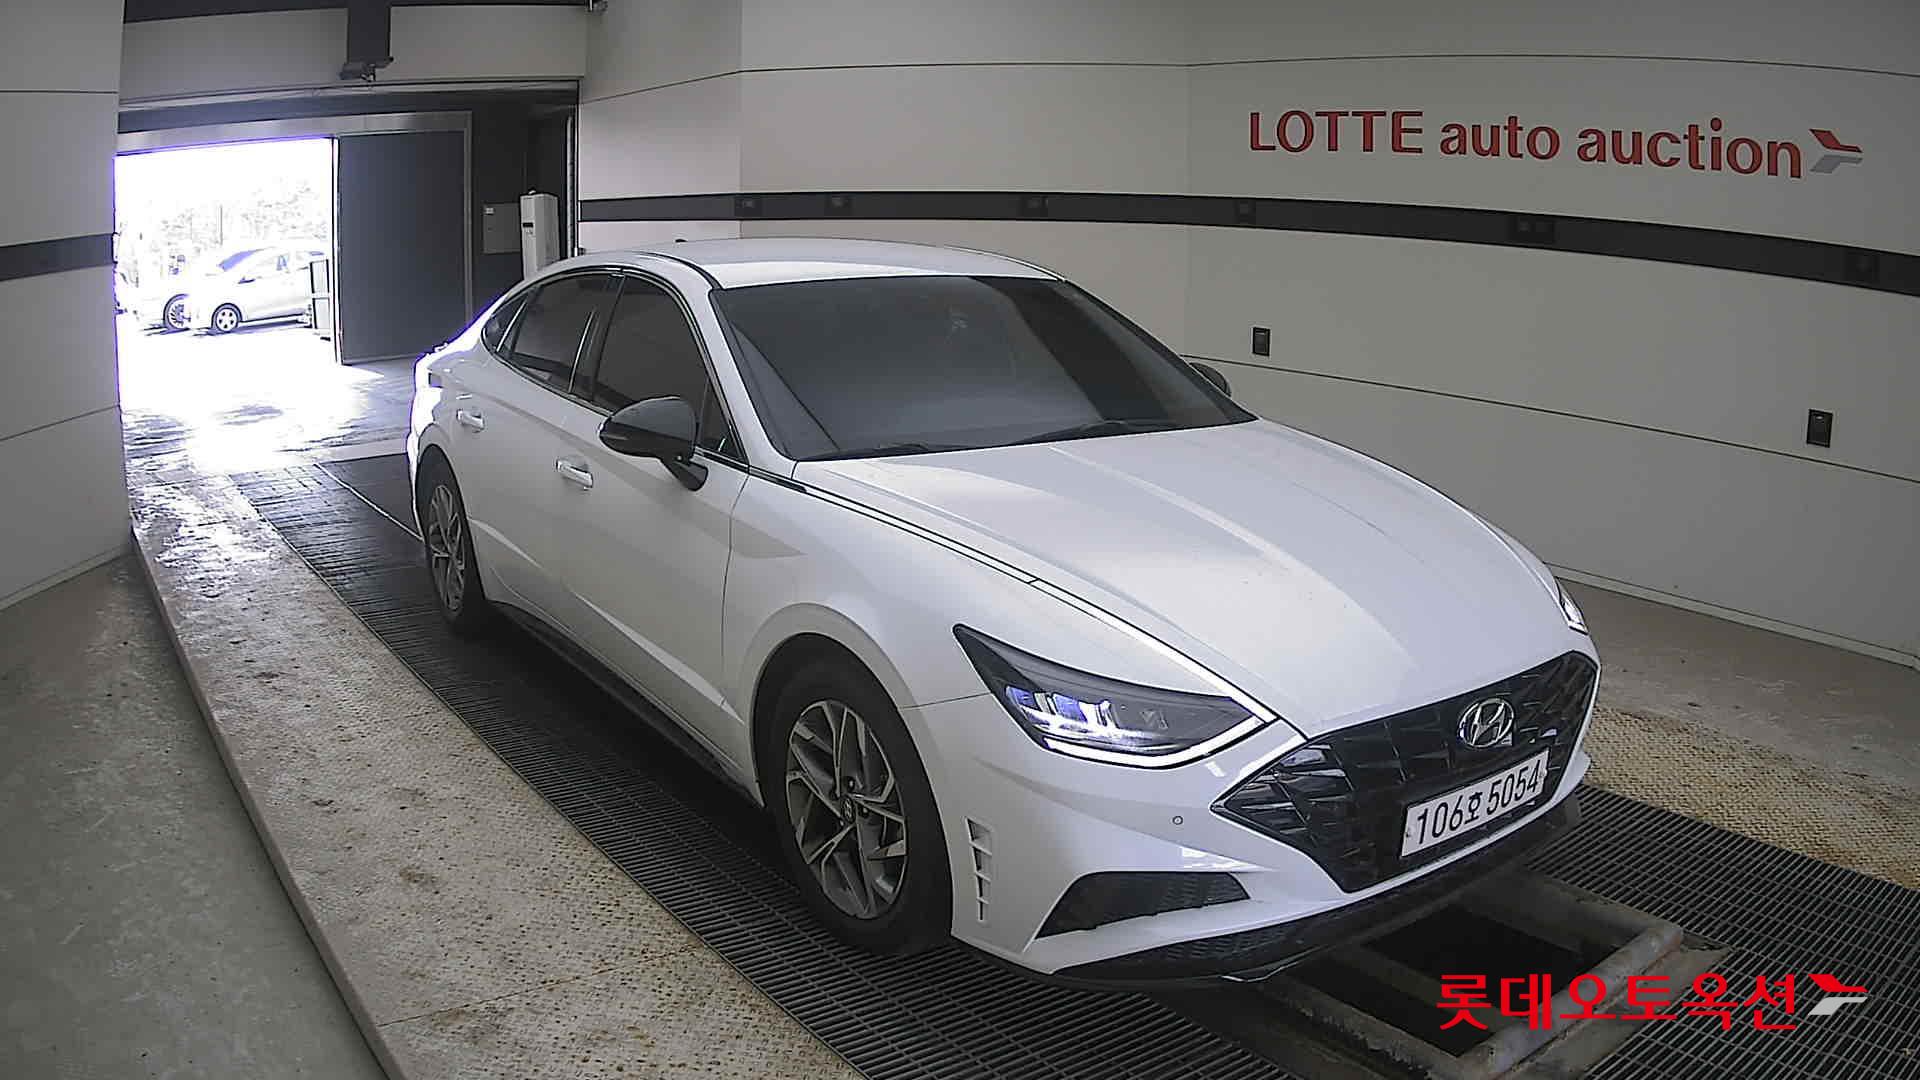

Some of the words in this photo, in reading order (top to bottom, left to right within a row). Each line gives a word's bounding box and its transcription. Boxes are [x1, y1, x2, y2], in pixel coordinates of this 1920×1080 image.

[1250, 111, 1424, 154] LOTTE
[1440, 116, 1560, 160] auto
[1577, 117, 1802, 179] auction
[1486, 759, 1541, 815] 5054
